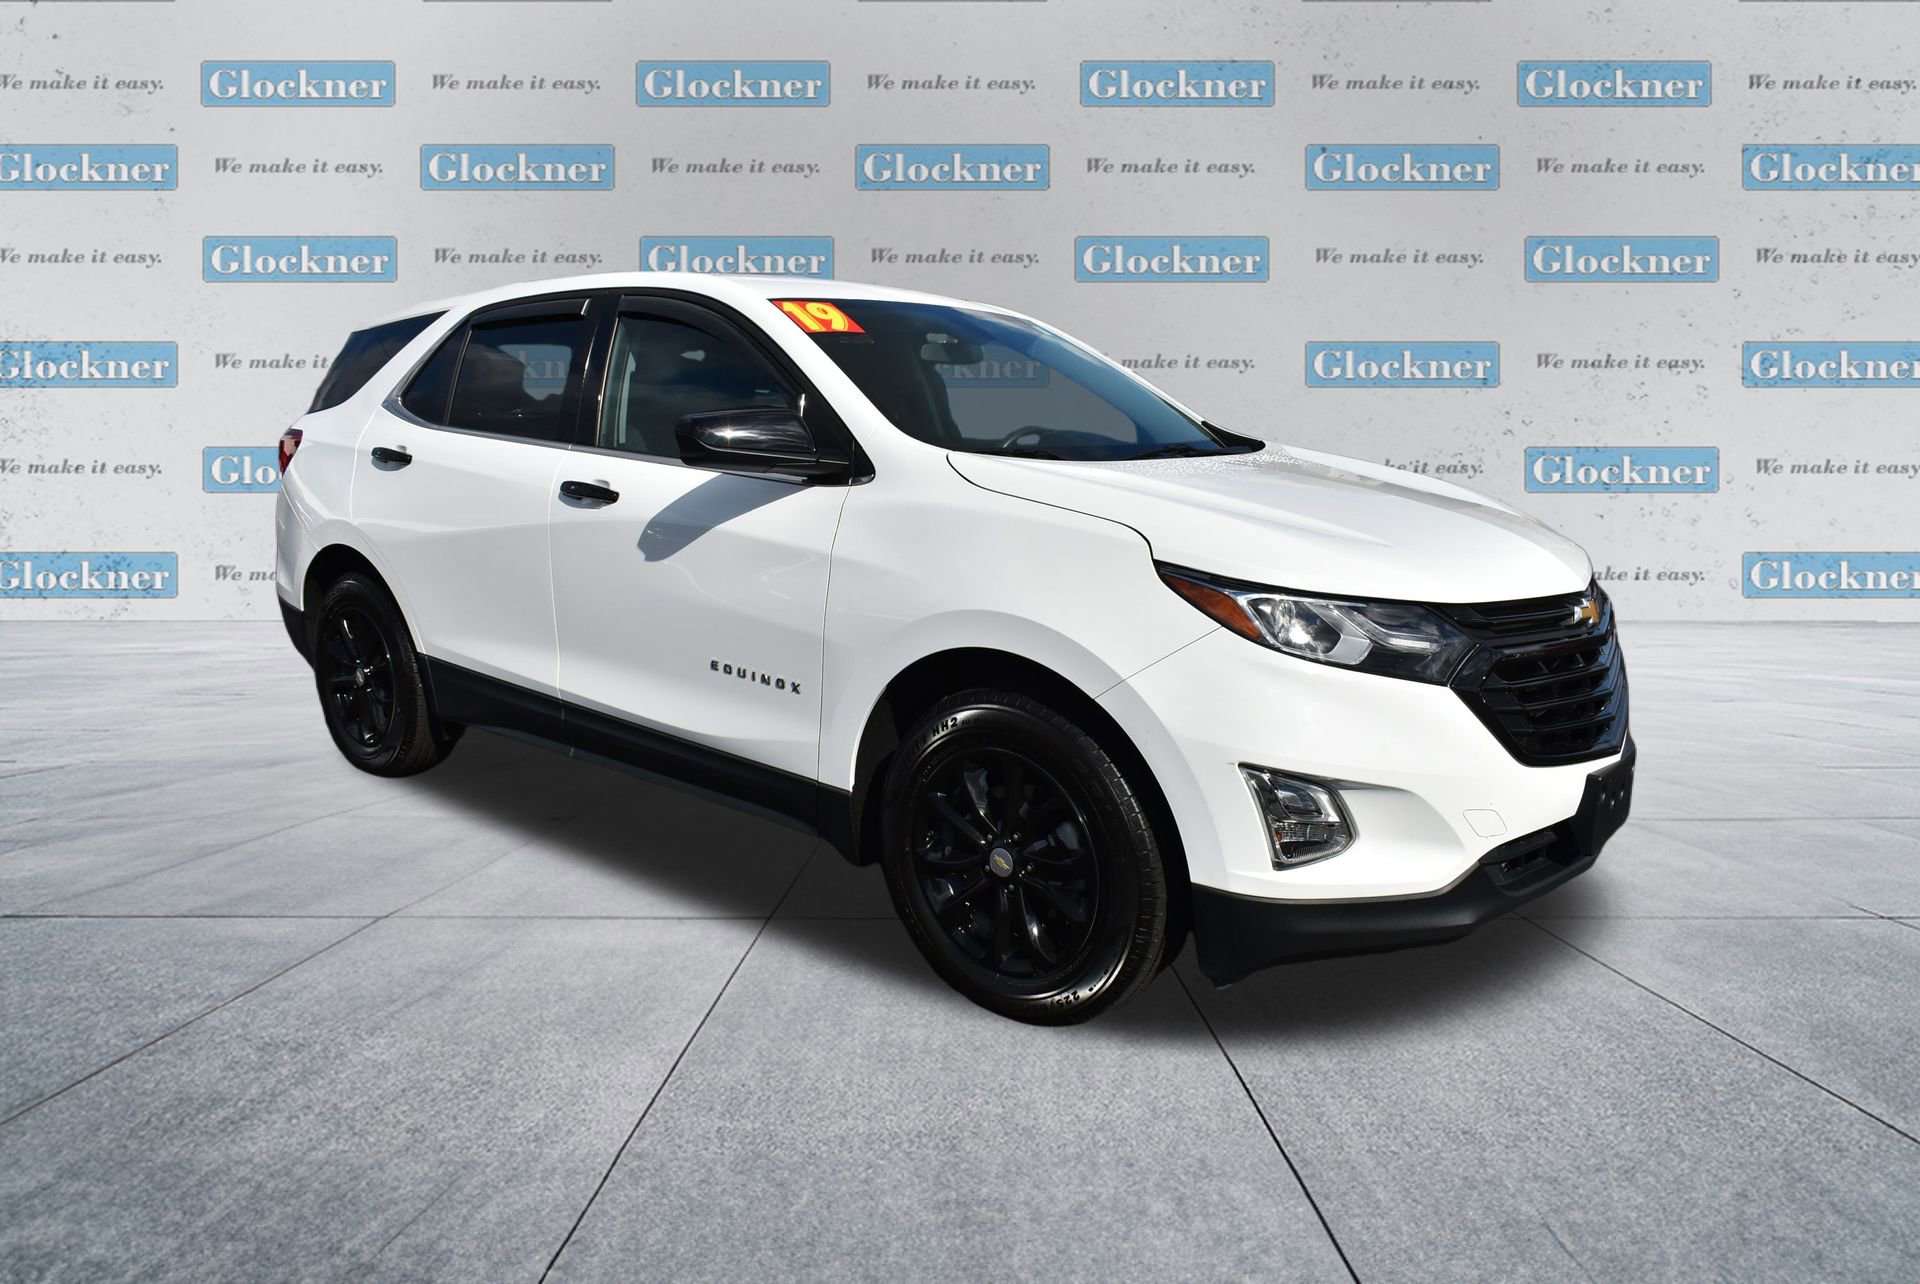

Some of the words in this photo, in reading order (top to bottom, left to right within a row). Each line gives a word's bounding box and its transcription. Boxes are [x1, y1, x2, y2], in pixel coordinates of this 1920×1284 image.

[29, 73, 87, 89] make
[93, 74, 109, 89] it
[115, 77, 164, 94] easy.
[209, 68, 388, 99] Glockner
[433, 73, 460, 89] We
[466, 73, 524, 89] make
[530, 74, 546, 89] it
[552, 77, 601, 94] easy.
[644, 68, 823, 99] Glockner
[868, 73, 895, 89] We
[901, 73, 959, 89] make
[965, 74, 981, 89] it
[987, 77, 1036, 94] easy.
[1088, 68, 1267, 99] Glockner
[1312, 73, 1339, 89] We
[1345, 73, 1403, 89] make
[1409, 74, 1425, 89] it
[1431, 77, 1480, 94] easy.
[1525, 68, 1704, 99] Glockner
[1749, 73, 1776, 89] We
[1782, 73, 1840, 89] make
[1846, 74, 1862, 89] it
[1868, 77, 1917, 94] easy.
[0, 152, 170, 183] Glockner
[215, 157, 242, 173] We
[248, 157, 306, 173] make
[312, 158, 328, 173] it
[334, 161, 383, 178] easy.
[428, 152, 607, 183] Glockner
[652, 157, 679, 173] We
[685, 157, 743, 173] make
[749, 158, 765, 173] it
[771, 161, 820, 178] easy.
[863, 152, 1042, 183] Glockner
[1087, 157, 1114, 173] We
[1120, 157, 1178, 173] make
[1184, 158, 1200, 173] it
[1206, 161, 1255, 178] easy.
[1313, 152, 1492, 183] Glockner
[1537, 157, 1564, 173] We
[1570, 157, 1628, 173] make
[1634, 158, 1650, 173] it
[1656, 161, 1705, 178] easy.
[27, 247, 85, 263] make
[91, 248, 107, 263] it
[113, 251, 162, 268] easy.
[210, 244, 389, 275] Glockner
[435, 247, 462, 263] We
[468, 247, 526, 263] make
[532, 248, 548, 263] it
[554, 251, 603, 268] easy.
[647, 244, 826, 274] Glockner
[871, 247, 898, 263] We
[904, 247, 962, 263] make
[968, 248, 984, 263] it
[990, 251, 1039, 268] easy.
[1082, 244, 1261, 275] Glockner
[1316, 247, 1343, 263] We
[1349, 247, 1407, 263] make
[1413, 248, 1429, 263] it
[1435, 251, 1484, 268] easy.
[1532, 244, 1711, 275] Glockner
[1756, 247, 1783, 263] We
[1789, 247, 1847, 263] make
[1853, 248, 1869, 263] it
[782, 302, 848, 332] 19
[0, 349, 170, 380] Glockner
[215, 353, 242, 369] We
[248, 353, 306, 369] make
[312, 354, 328, 369] it
[1121, 353, 1178, 369] make
[1184, 354, 1200, 369] it
[1206, 357, 1255, 374] easy.
[1313, 349, 1492, 380] Glockner
[1537, 353, 1564, 369] We
[1570, 353, 1628, 369] make
[1634, 354, 1650, 369] it
[1656, 357, 1705, 374] easy.
[27, 458, 85, 474] make
[91, 459, 107, 474] it
[113, 462, 162, 479] easy.
[1435, 461, 1484, 478] easy.
[1532, 454, 1711, 485] Glockner
[1756, 458, 1783, 474] We
[1789, 458, 1847, 474] make
[1853, 459, 1869, 474] it
[0, 560, 170, 591] Glockner
[215, 565, 242, 581] We
[1634, 566, 1650, 581] it
[1656, 569, 1705, 586] easy.
[710, 659, 801, 695] EQUINOX
